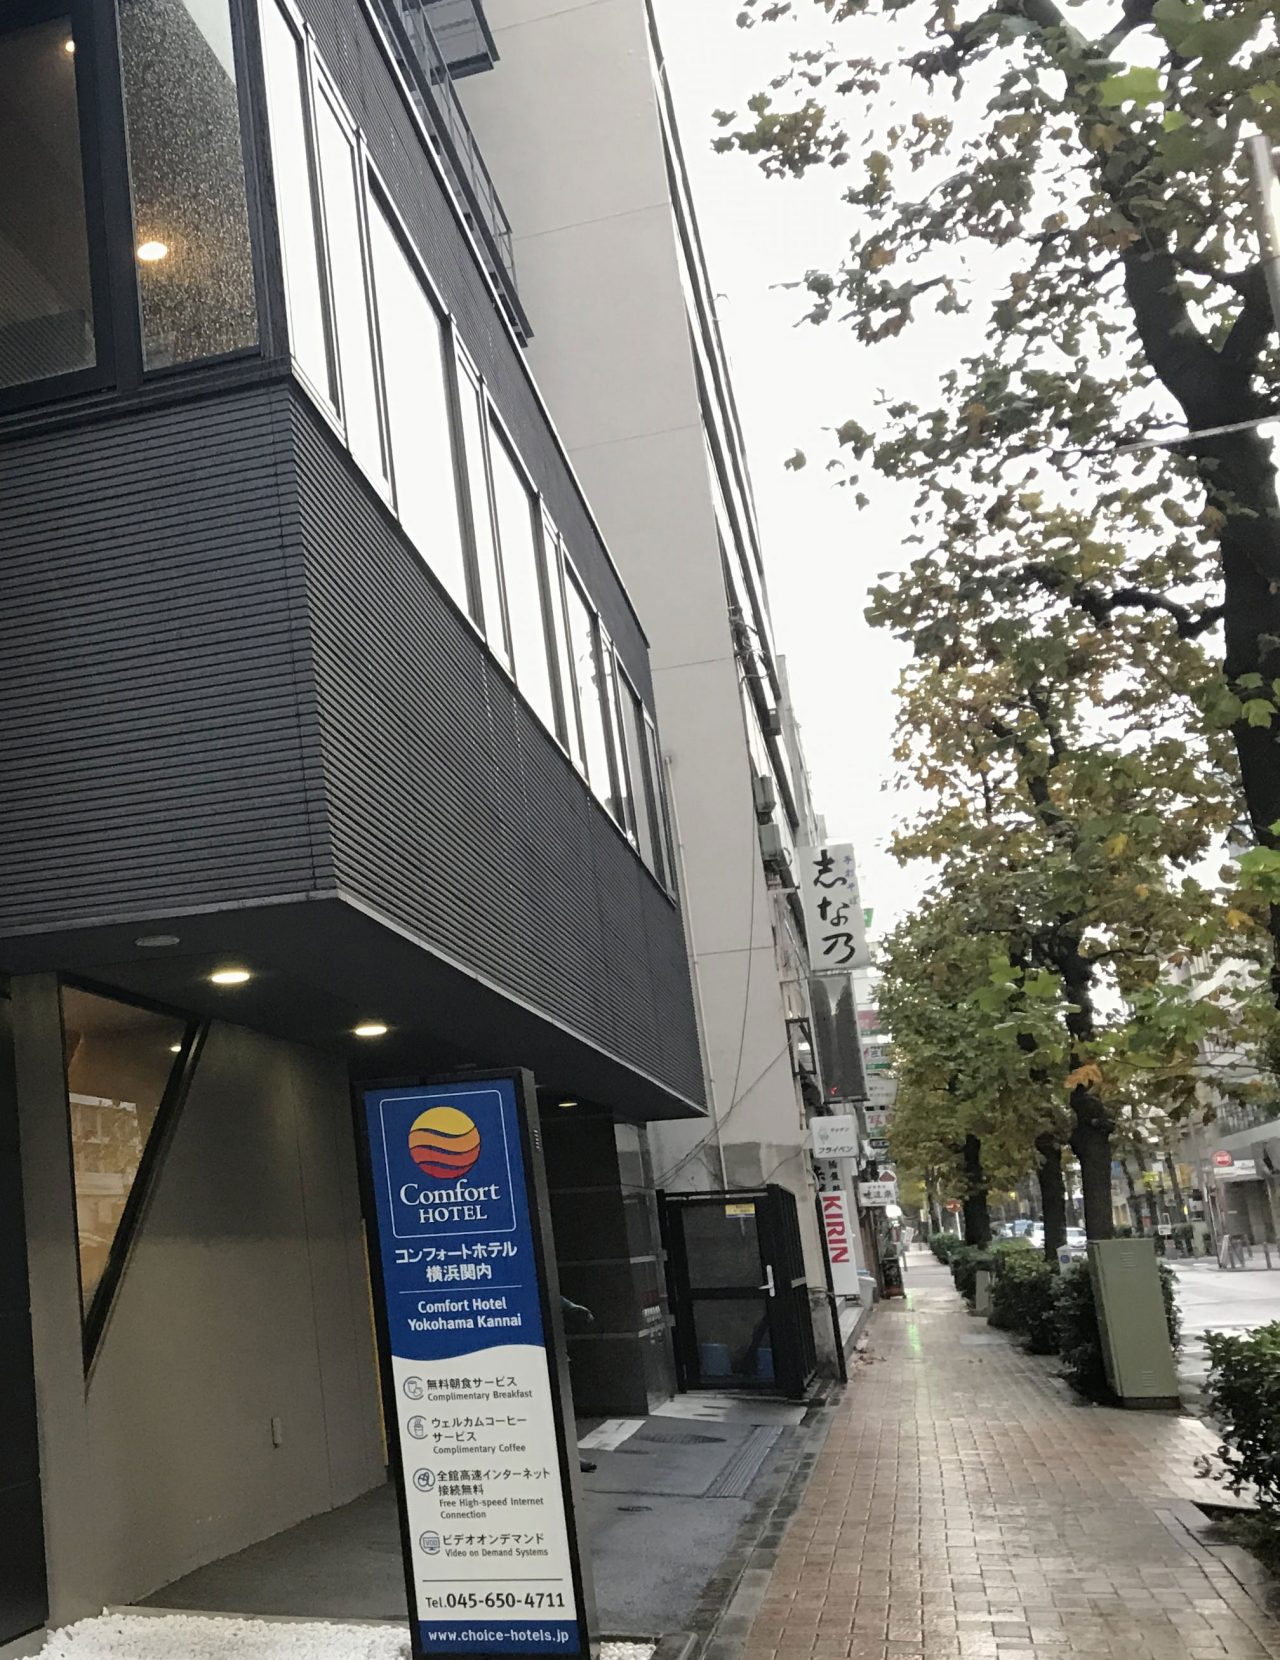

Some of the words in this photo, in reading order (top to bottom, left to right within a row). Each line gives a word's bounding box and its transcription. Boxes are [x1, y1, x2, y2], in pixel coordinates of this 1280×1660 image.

[400, 1179, 501, 1206] Comfort
[419, 1205, 488, 1224] HOTEL
[822, 1196, 850, 1263] KIRIN
[395, 1241, 518, 1264] コンフォートホテル
[426, 1263, 492, 1283] 横浜関内
[418, 1299, 470, 1314] Comfort
[472, 1296, 508, 1311] Hotel
[408, 1316, 474, 1332] Yokohama
[477, 1313, 523, 1329] Kannai
[426, 1376, 518, 1390] 無料朝食サービス
[427, 1390, 491, 1402] Complimentary
[493, 1389, 533, 1400] Breakfast
[431, 1416, 527, 1428] ウェルカムコーヒー
[432, 1431, 478, 1443] サービス
[433, 1444, 496, 1456] Complimentary
[498, 1443, 526, 1453] Coffee
[437, 1467, 551, 1482] 全館高速インターネット
[438, 1484, 485, 1496] 接続無料
[439, 1498, 457, 1508] Free
[459, 1497, 508, 1509] High-speed
[510, 1496, 544, 1506] Internet
[440, 1510, 487, 1520] Connection
[442, 1533, 544, 1545] ビデオオンデマンド
[445, 1548, 467, 1557] Video
[469, 1549, 480, 1557] on
[481, 1547, 512, 1557] Demand
[515, 1547, 549, 1559] Systems
[428, 1629, 569, 1644] www.choice-hotels.jp
